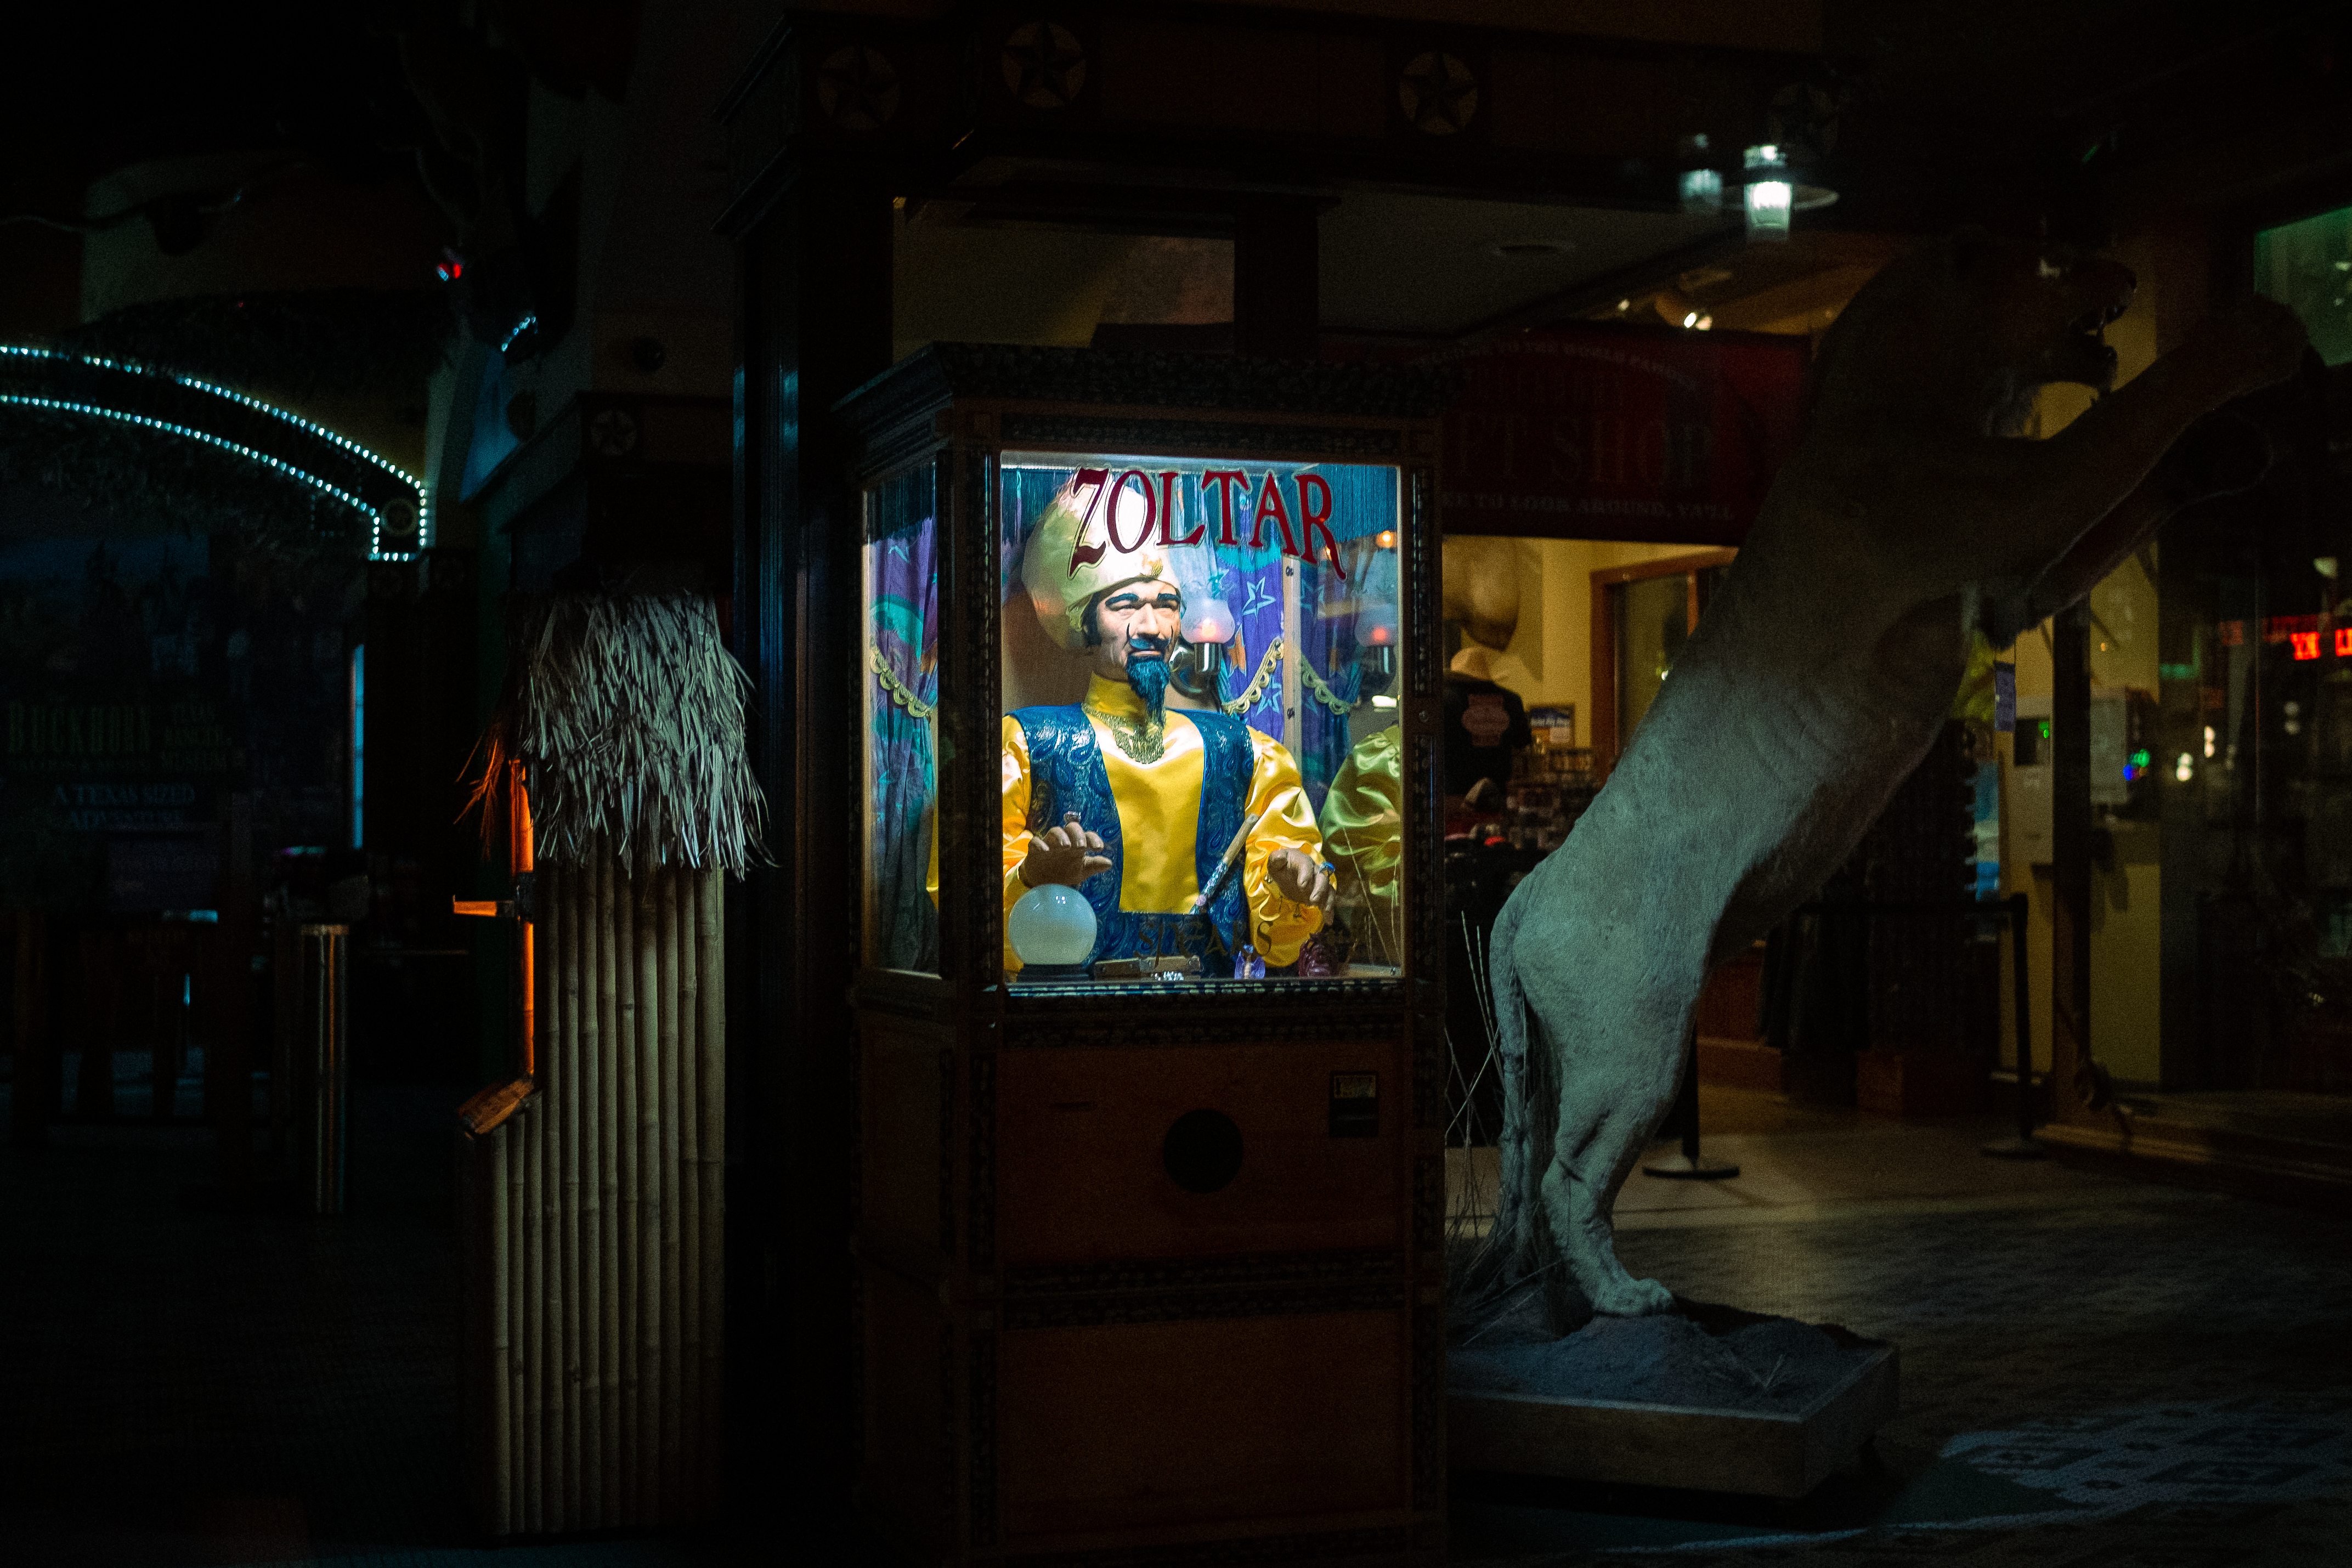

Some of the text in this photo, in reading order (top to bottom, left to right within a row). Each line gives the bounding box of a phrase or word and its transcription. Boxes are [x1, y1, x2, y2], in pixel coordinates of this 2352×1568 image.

[1523, 341, 1559, 355] THE
[1562, 343, 1626, 364] WORLD
[1455, 410, 1713, 487] FT SHOP
[1473, 493, 1504, 510] TO
[1510, 495, 1571, 513] LOOK
[1576, 497, 1673, 519] AROUND,
[1068, 465, 1347, 580] ZOLTAR
[70, 783, 138, 806] TEXAS
[142, 782, 196, 806] SIZED
